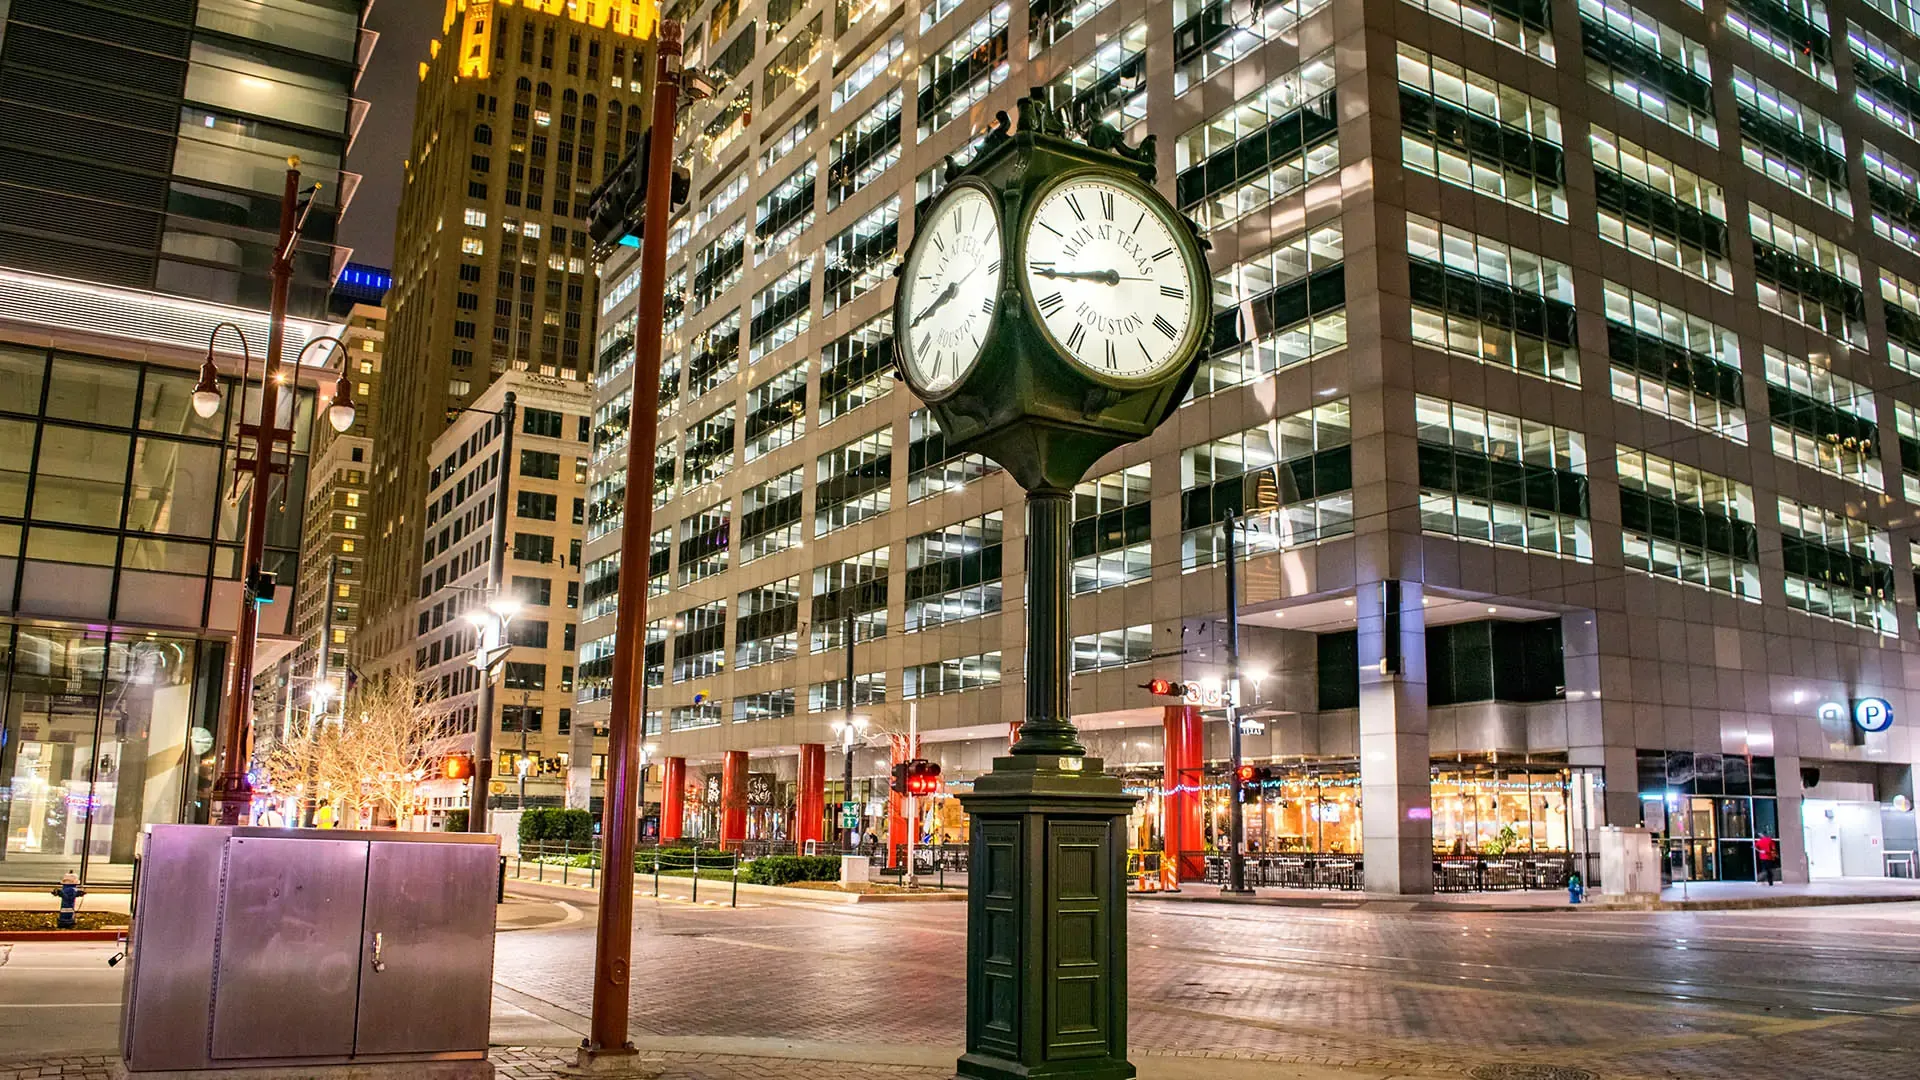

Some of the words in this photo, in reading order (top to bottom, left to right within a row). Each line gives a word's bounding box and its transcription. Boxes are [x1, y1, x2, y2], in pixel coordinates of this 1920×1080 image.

[931, 251, 950, 293] MAIN
[951, 238, 961, 256] AT
[963, 234, 985, 266] TEXAS
[1062, 225, 1094, 261] MAIN
[1098, 224, 1112, 240] AT
[1117, 229, 1153, 276] TEXAS
[938, 310, 976, 348] HOUSTON
[1076, 301, 1144, 336] HOUSTON
[1242, 727, 1262, 736] TEXAS
[1866, 706, 1880, 725] P
